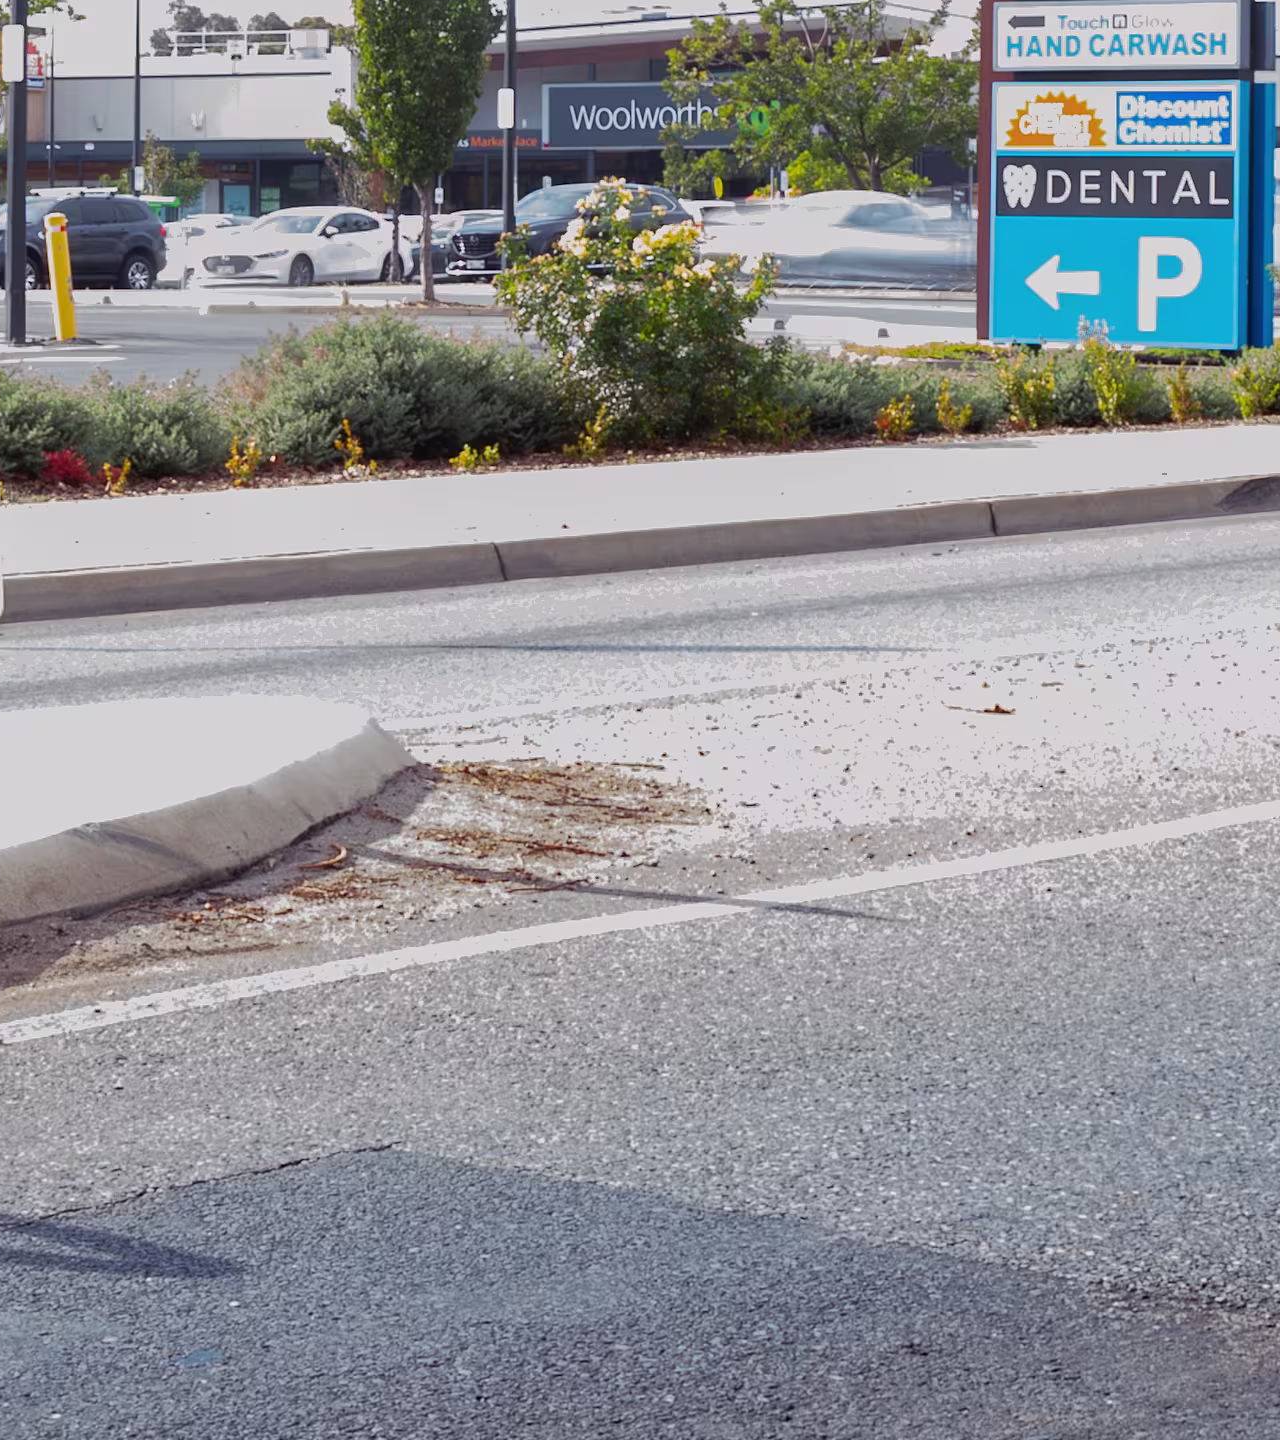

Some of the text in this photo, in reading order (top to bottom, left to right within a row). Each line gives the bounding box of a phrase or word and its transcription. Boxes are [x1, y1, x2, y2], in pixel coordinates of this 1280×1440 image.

[1057, 14, 1109, 30] Touch
[1007, 32, 1227, 57] HAND CARWASH
[1046, 169, 1230, 205] DENTAL
[1137, 236, 1203, 333] P
